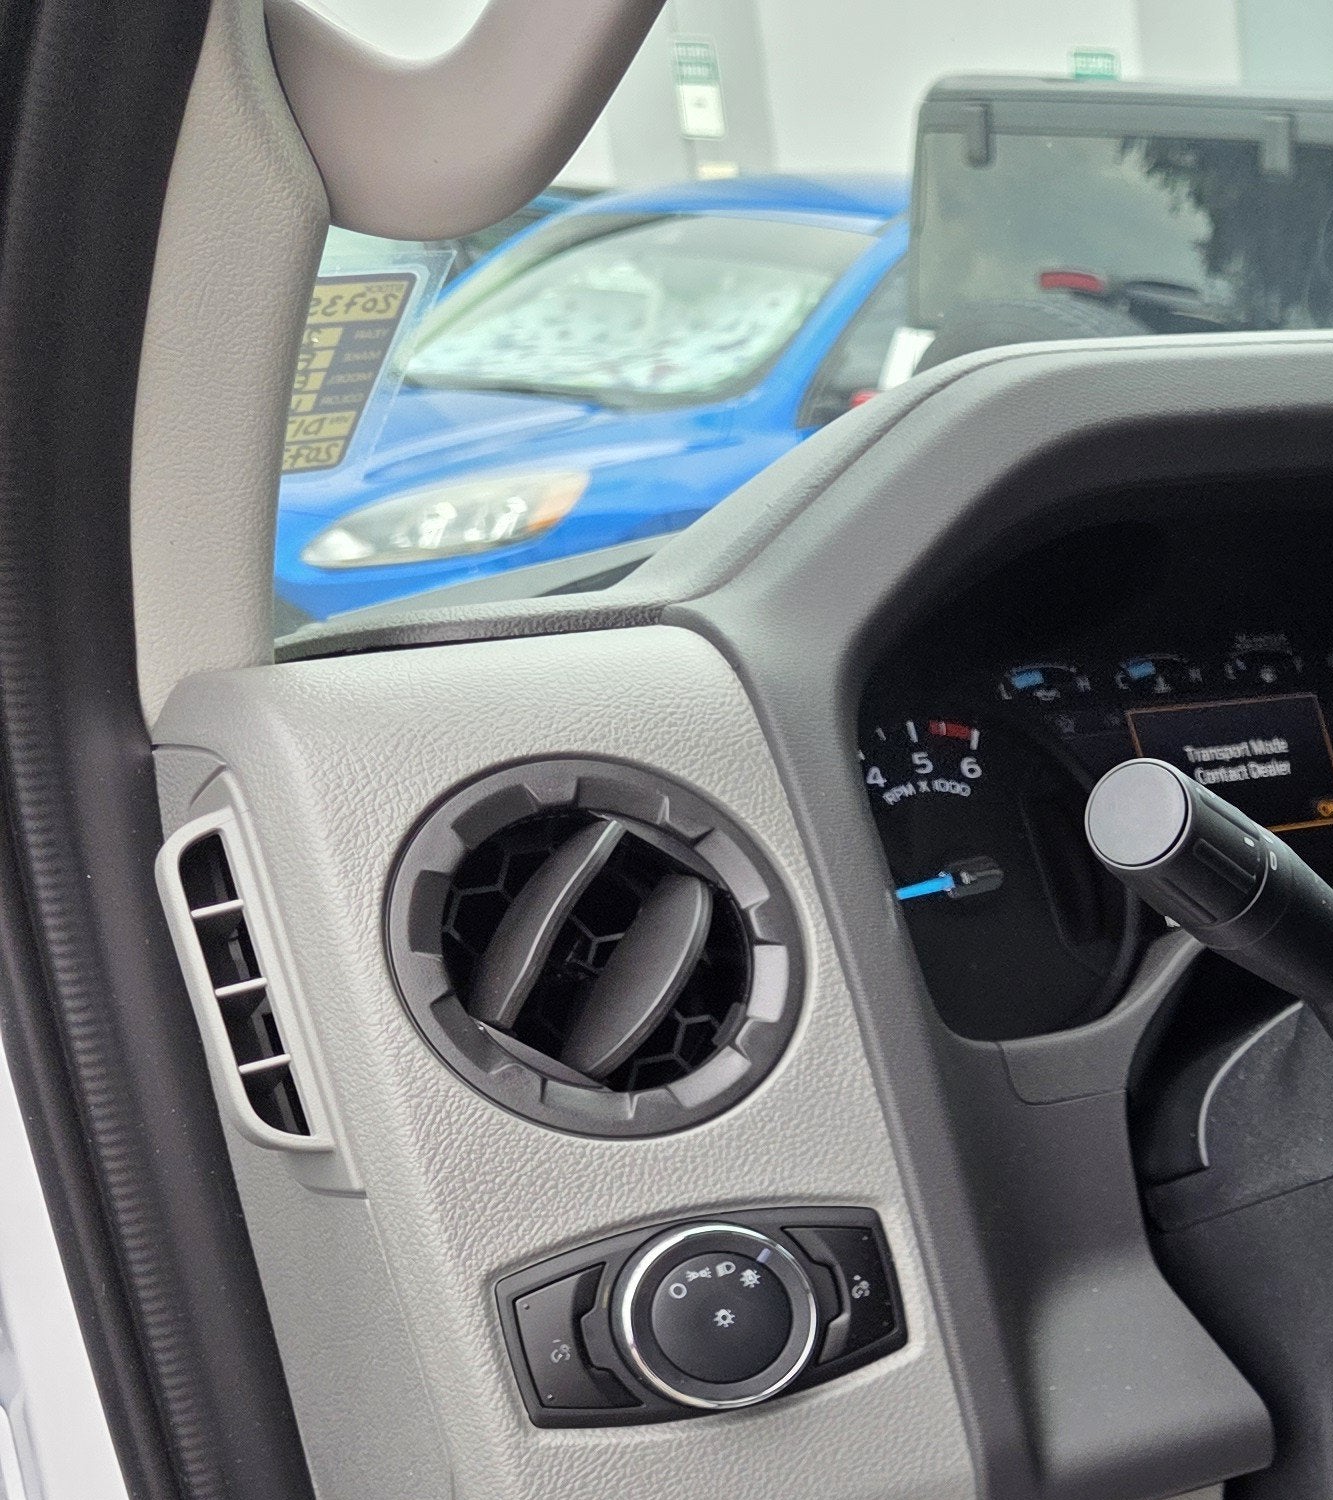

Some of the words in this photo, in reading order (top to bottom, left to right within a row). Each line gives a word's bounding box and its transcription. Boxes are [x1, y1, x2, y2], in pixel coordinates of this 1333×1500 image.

[1184, 739, 1251, 763] Transport
[1250, 736, 1290, 755] Mode
[911, 751, 934, 774] 5
[960, 757, 982, 779] 6
[1194, 763, 1250, 786] Contact
[1248, 758, 1292, 780] Dealer
[866, 766, 887, 787] 4
[883, 781, 916, 805] RPM
[931, 777, 972, 797] 1000
